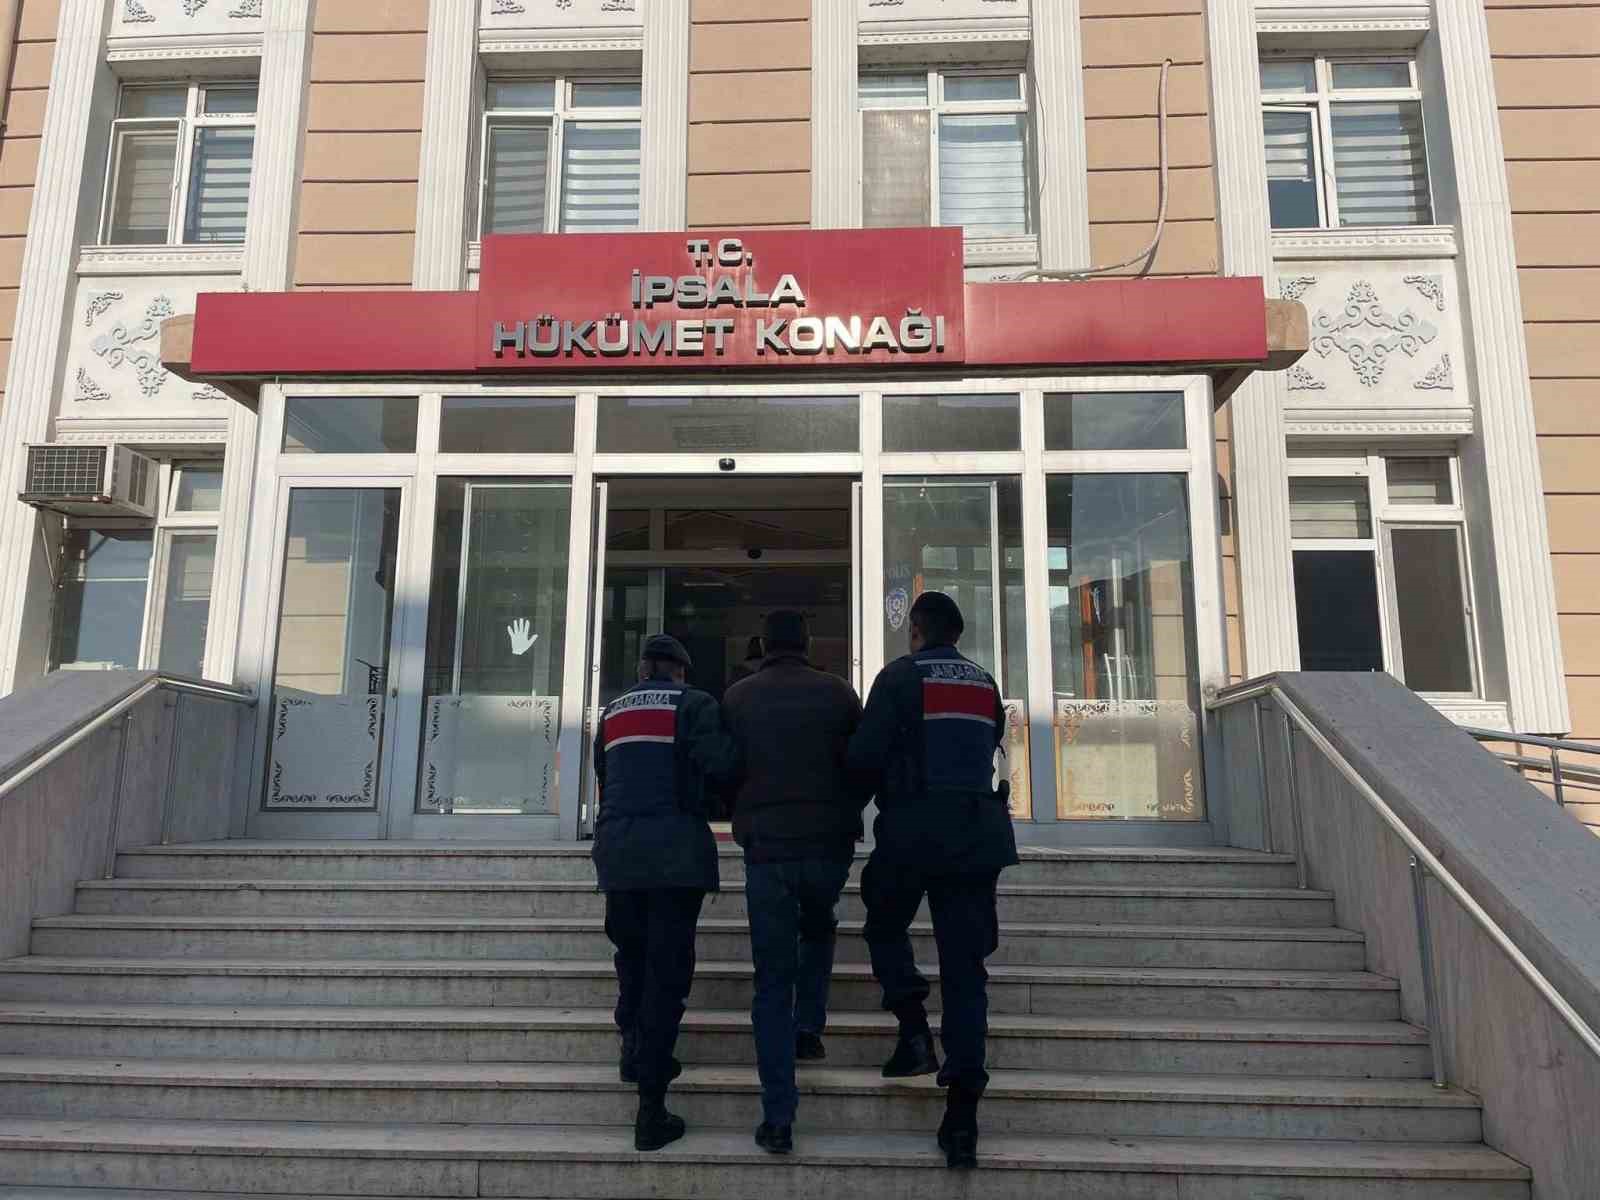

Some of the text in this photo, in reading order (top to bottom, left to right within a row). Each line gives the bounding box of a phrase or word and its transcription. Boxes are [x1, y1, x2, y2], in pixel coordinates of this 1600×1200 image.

[687, 238, 753, 266] T.C.
[632, 269, 805, 307] İPSALA
[493, 307, 945, 357] HÜKÜMET KONAĞI
